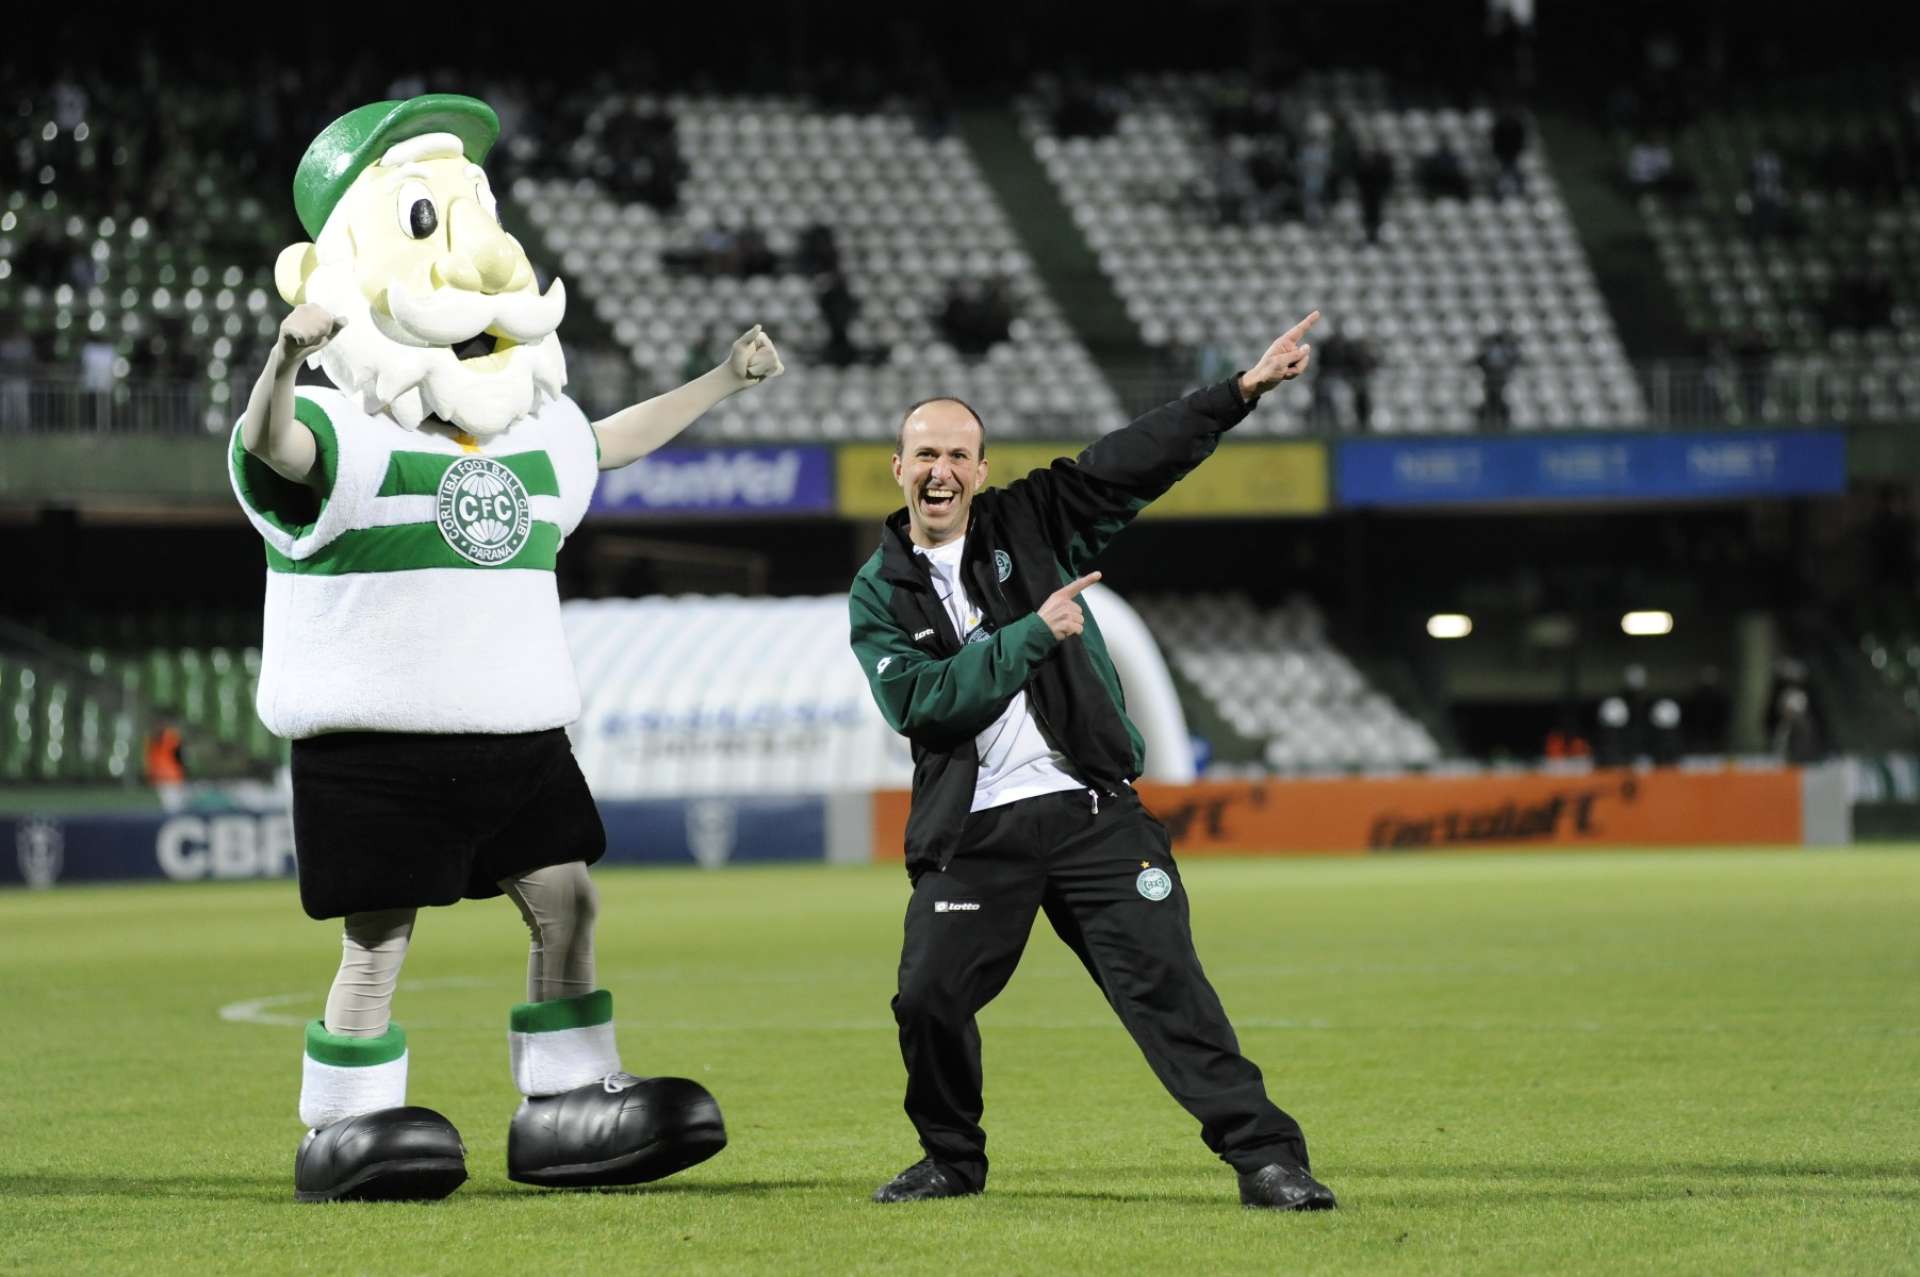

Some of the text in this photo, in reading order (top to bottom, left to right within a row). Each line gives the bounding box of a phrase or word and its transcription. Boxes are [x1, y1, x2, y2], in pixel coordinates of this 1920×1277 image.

[440, 460, 529, 540] CORITIBA FOOT BALL CLUB
[458, 495, 513, 521] CFC
[949, 902, 981, 911] lotto
